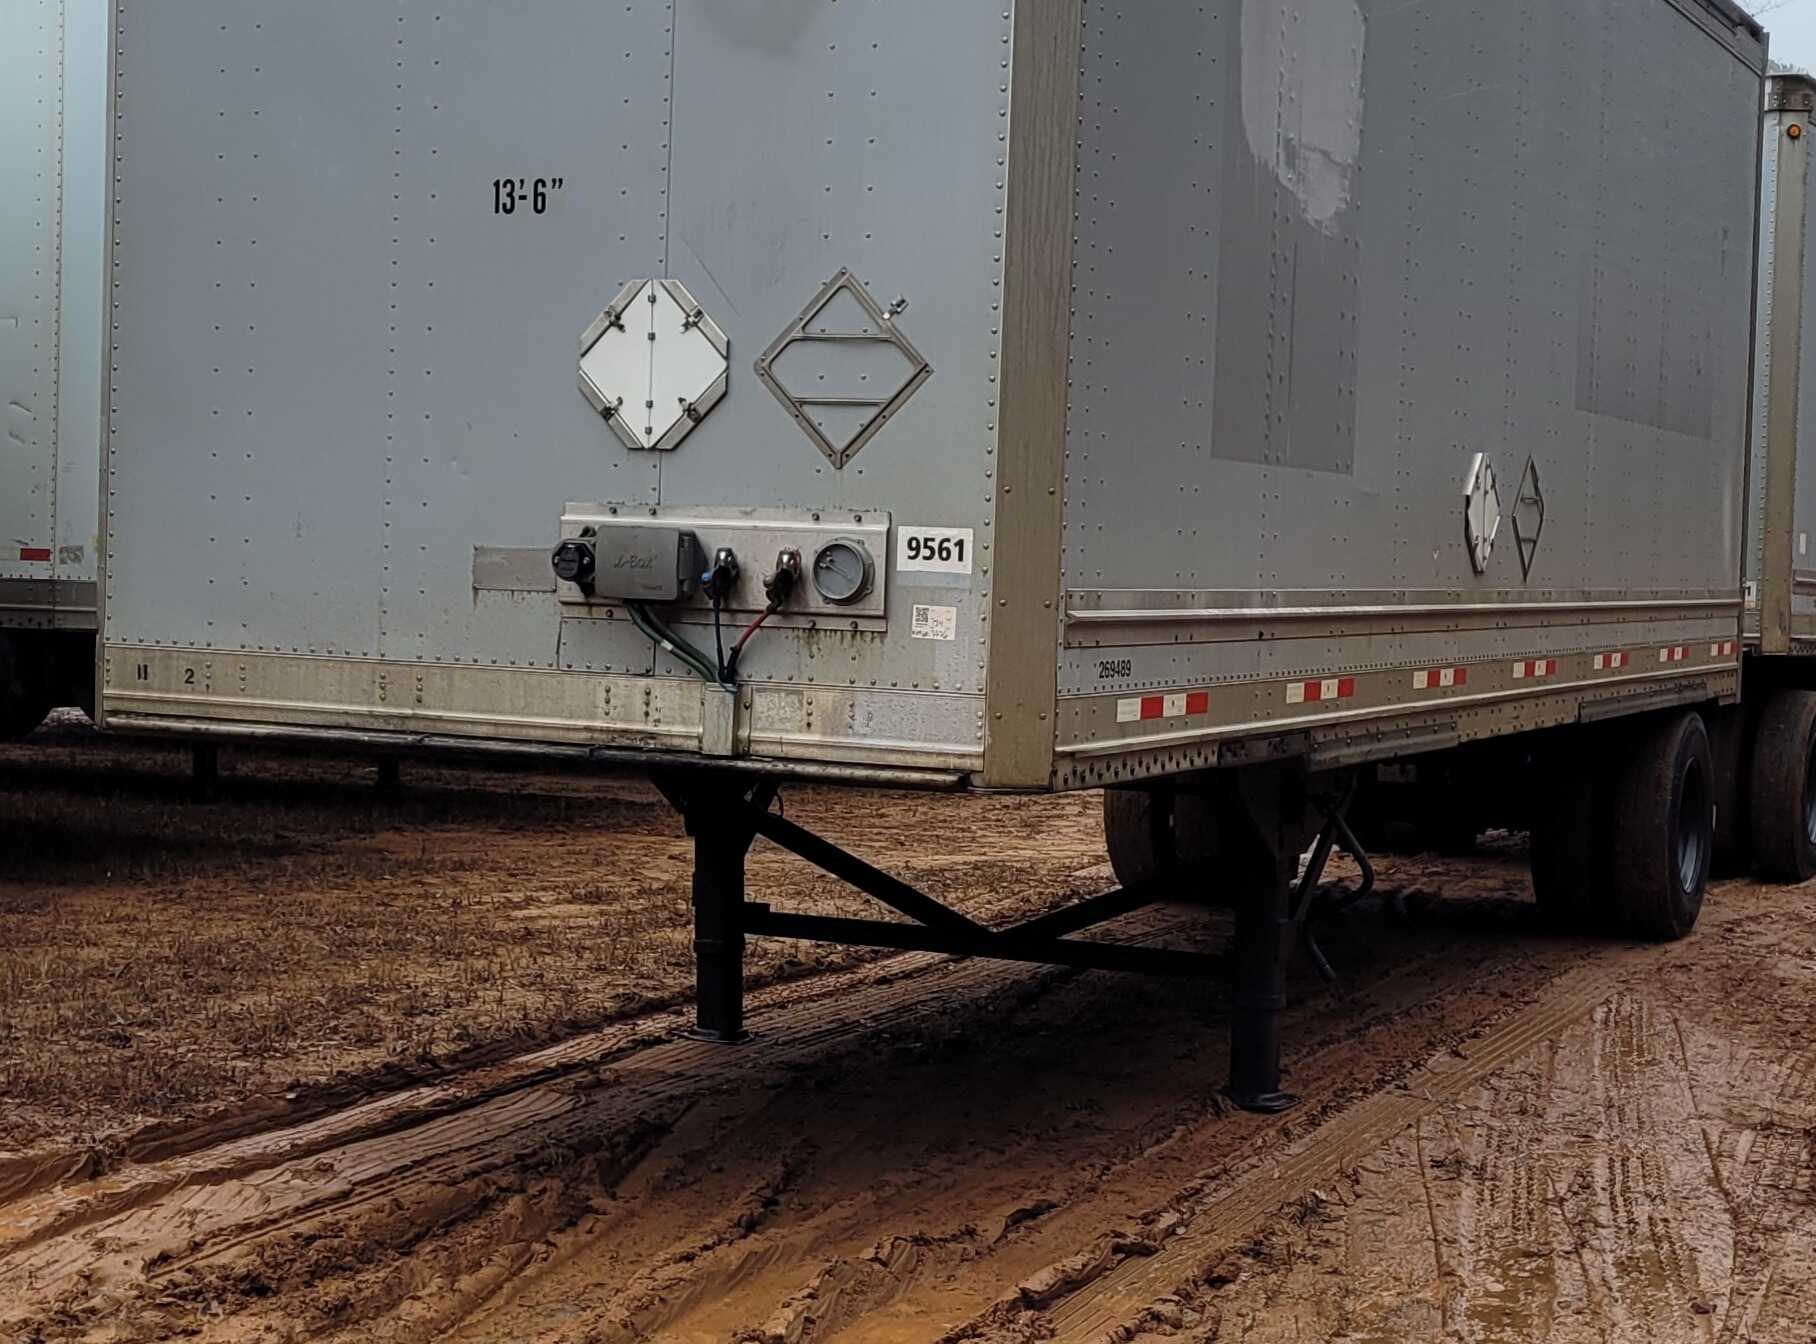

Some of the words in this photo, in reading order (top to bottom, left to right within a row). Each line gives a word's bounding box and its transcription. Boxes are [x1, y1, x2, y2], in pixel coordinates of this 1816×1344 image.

[907, 537, 964, 562] 9561
[184, 668, 195, 684] 2
[1098, 659, 1131, 679] 269489
